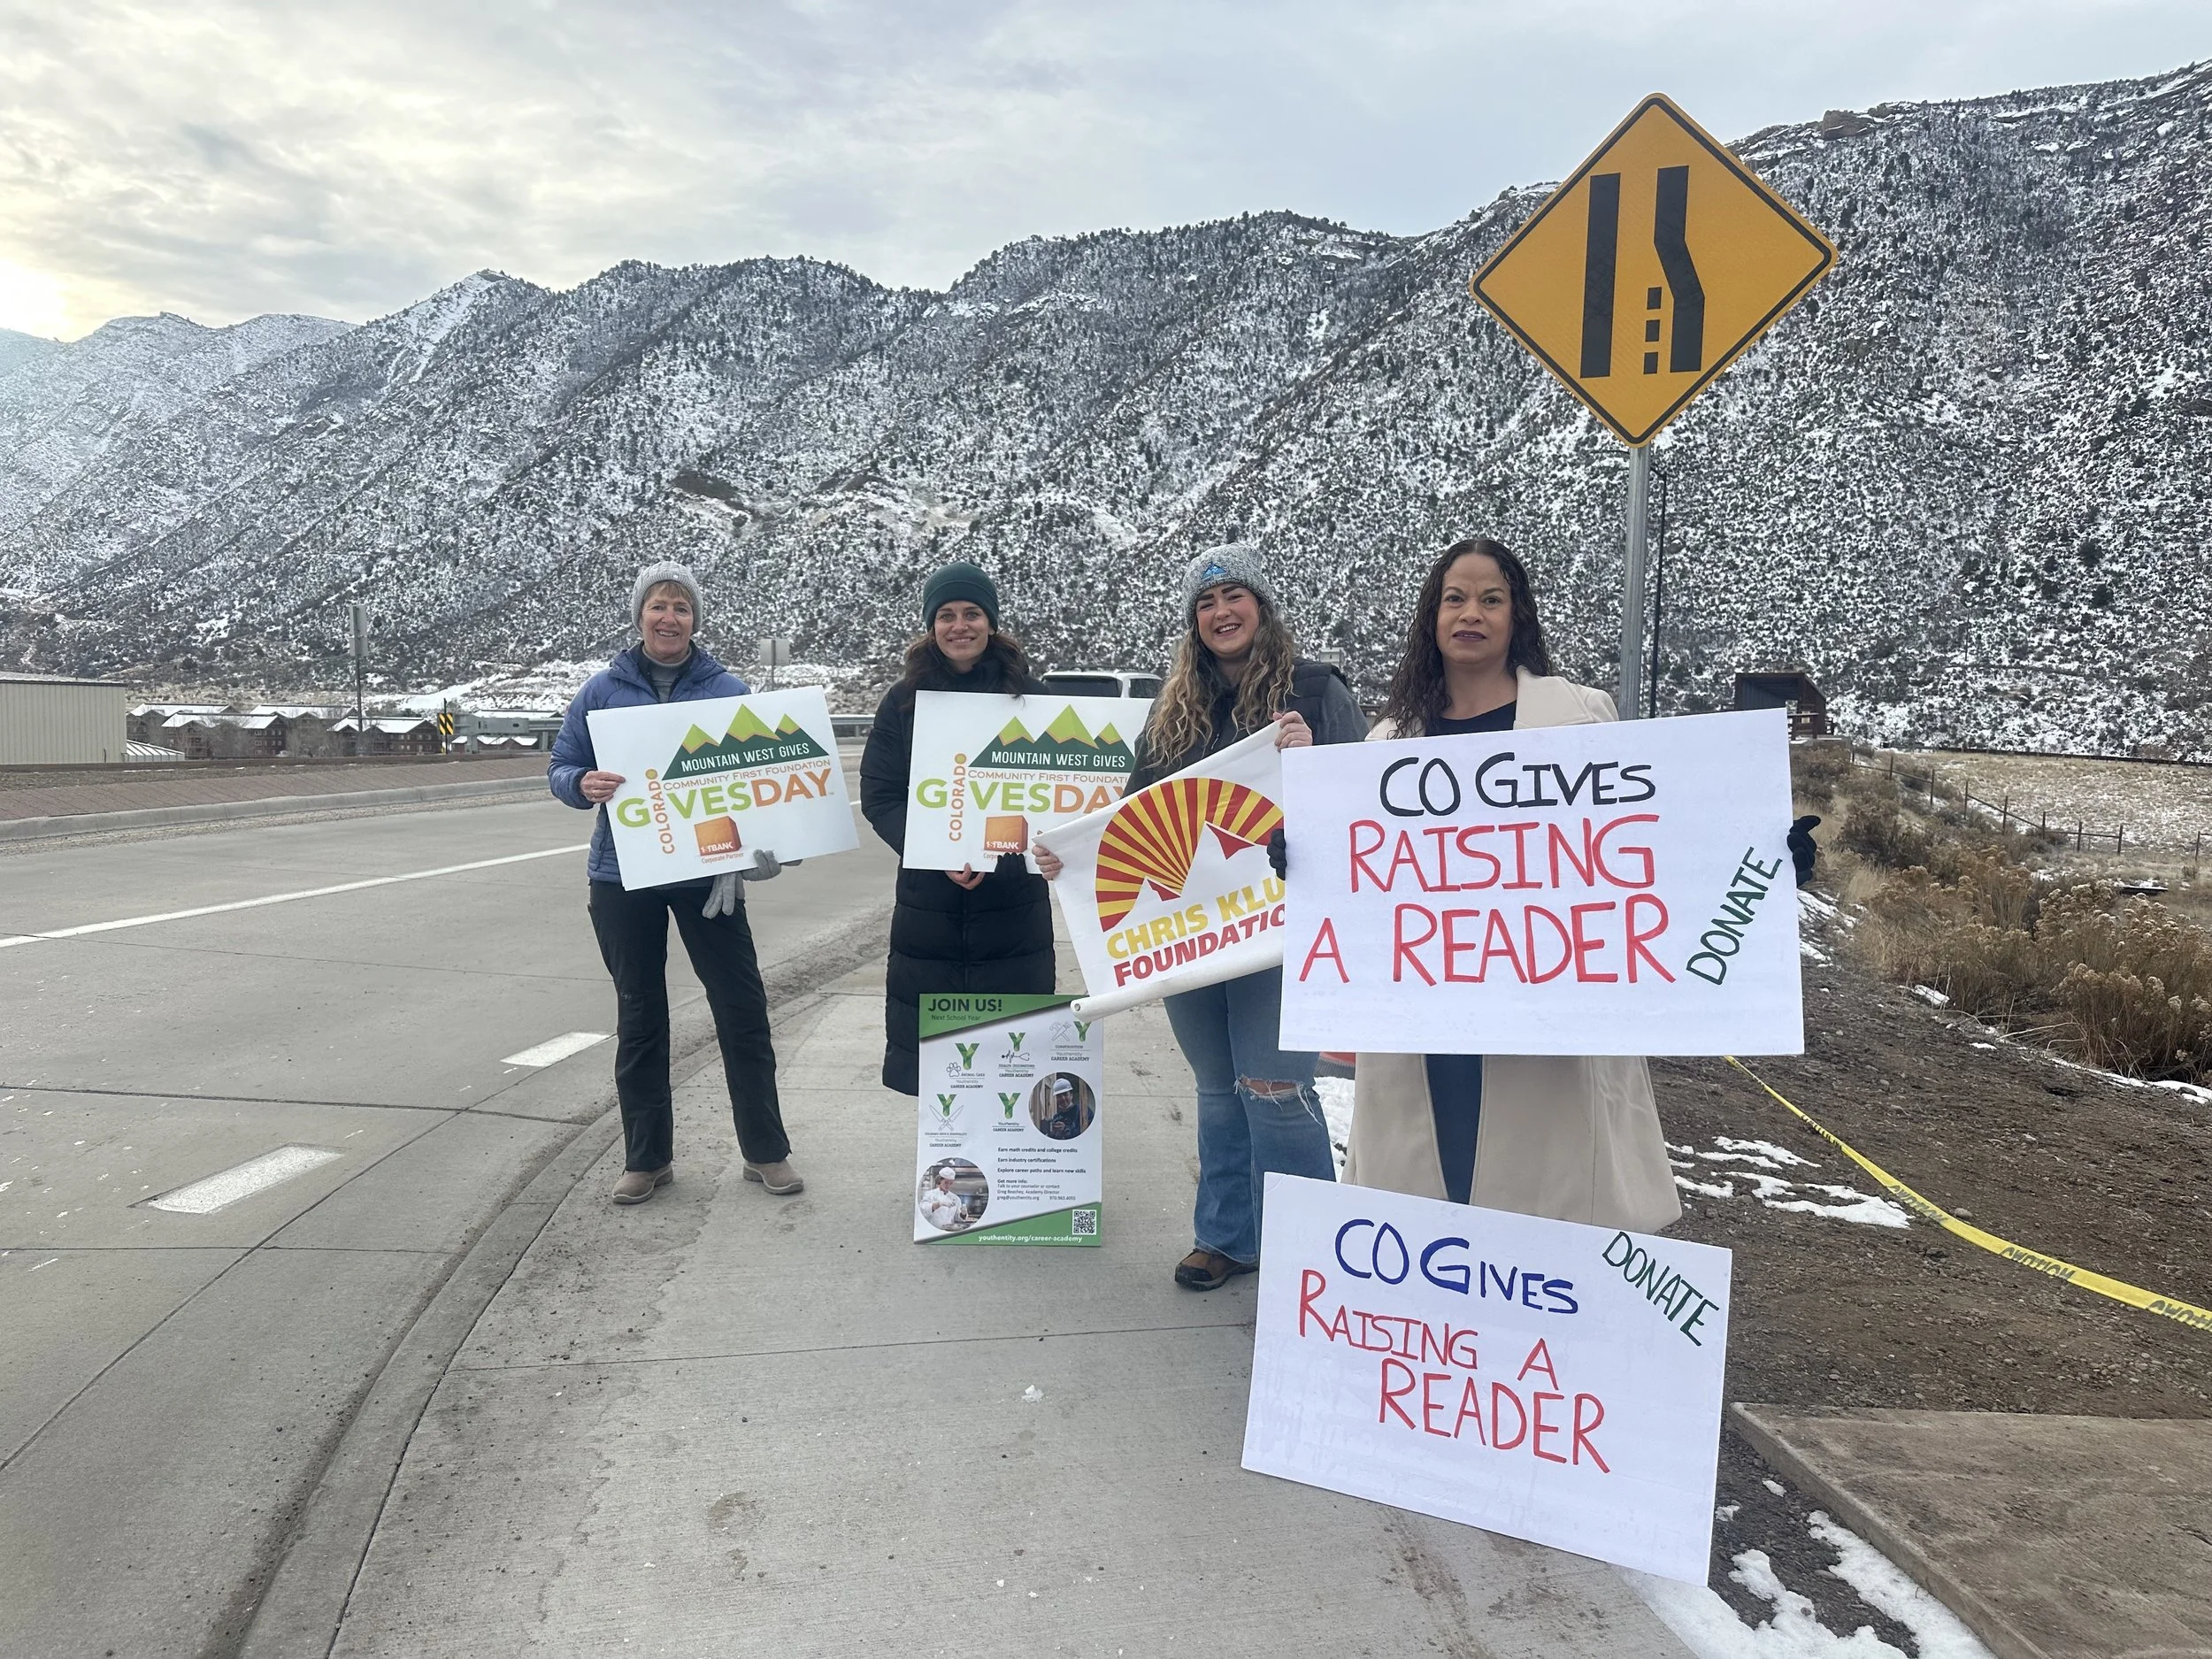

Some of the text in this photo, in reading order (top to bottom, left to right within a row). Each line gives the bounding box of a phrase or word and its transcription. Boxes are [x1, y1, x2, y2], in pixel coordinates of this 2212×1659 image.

[663, 759, 831, 791] COMMUNITY FIRST FOUNDATION
[681, 742, 810, 772] MOUNTAIN WEST GIVES
[949, 753, 967, 841] COLORADO
[968, 770, 1127, 784] COMMUNITY FIRST FOUNDATI
[991, 751, 1125, 768] MOUNTAIN WEST GIVES
[1379, 752, 1656, 817] CO GIVES
[645, 768, 675, 855] COLORADO
[1349, 814, 1660, 894] RAISING
[1106, 876, 1285, 960] CHRIS KLU
[1113, 903, 1285, 987] FOUNDATIO
[1299, 894, 1676, 987] A READER
[1686, 847, 1783, 986] DONATE
[928, 998, 1002, 1012] JOIN US!
[978, 1234, 1083, 1243] youthentity.org/career-academy
[1334, 1218, 1578, 1314] CO GIVES
[1299, 1269, 1559, 1390] RAISING A
[1601, 1231, 1719, 1347] DONATE
[1379, 1358, 1610, 1473] READER
